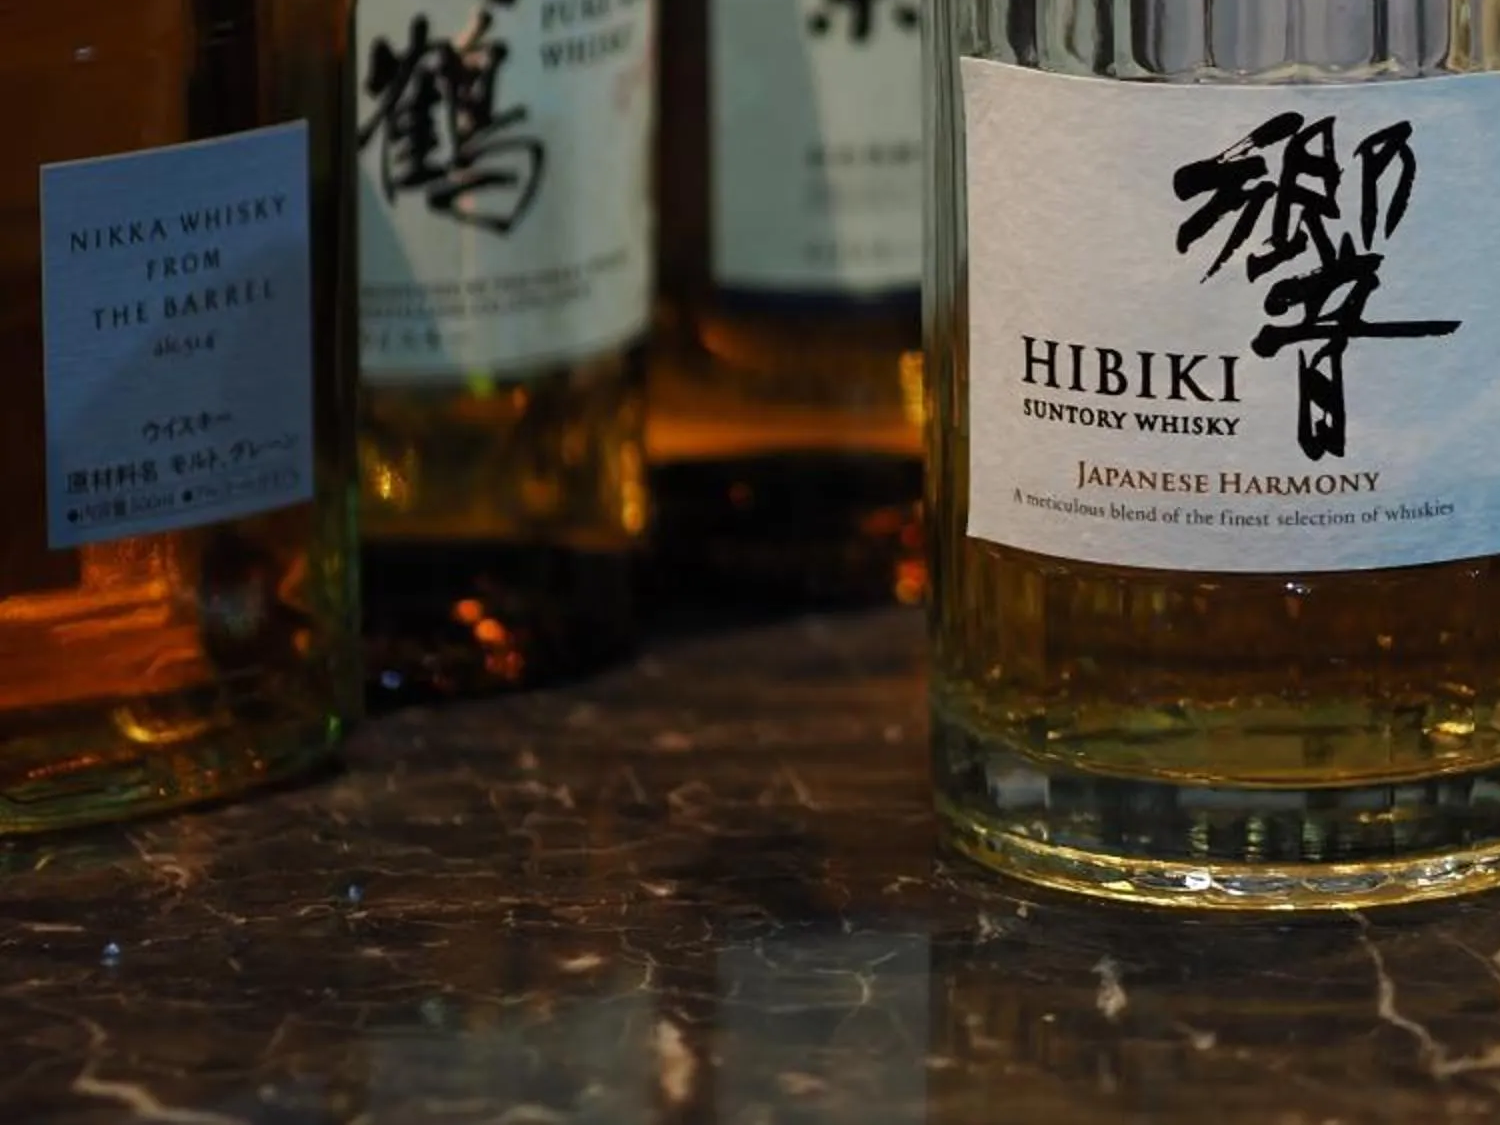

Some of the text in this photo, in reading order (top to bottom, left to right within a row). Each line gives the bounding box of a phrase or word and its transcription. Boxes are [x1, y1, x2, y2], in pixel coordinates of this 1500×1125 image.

[70, 194, 287, 253] NIKKA WHISKY
[146, 247, 221, 281] FROM
[92, 276, 276, 331] THE BARREL
[1022, 335, 1241, 402] HIBIKI
[141, 410, 232, 443] ウイスキー
[1023, 398, 1240, 437] SUNTORY WHISKY
[1013, 487, 1455, 527] A meticulous blend of the finest selection of whiskies
